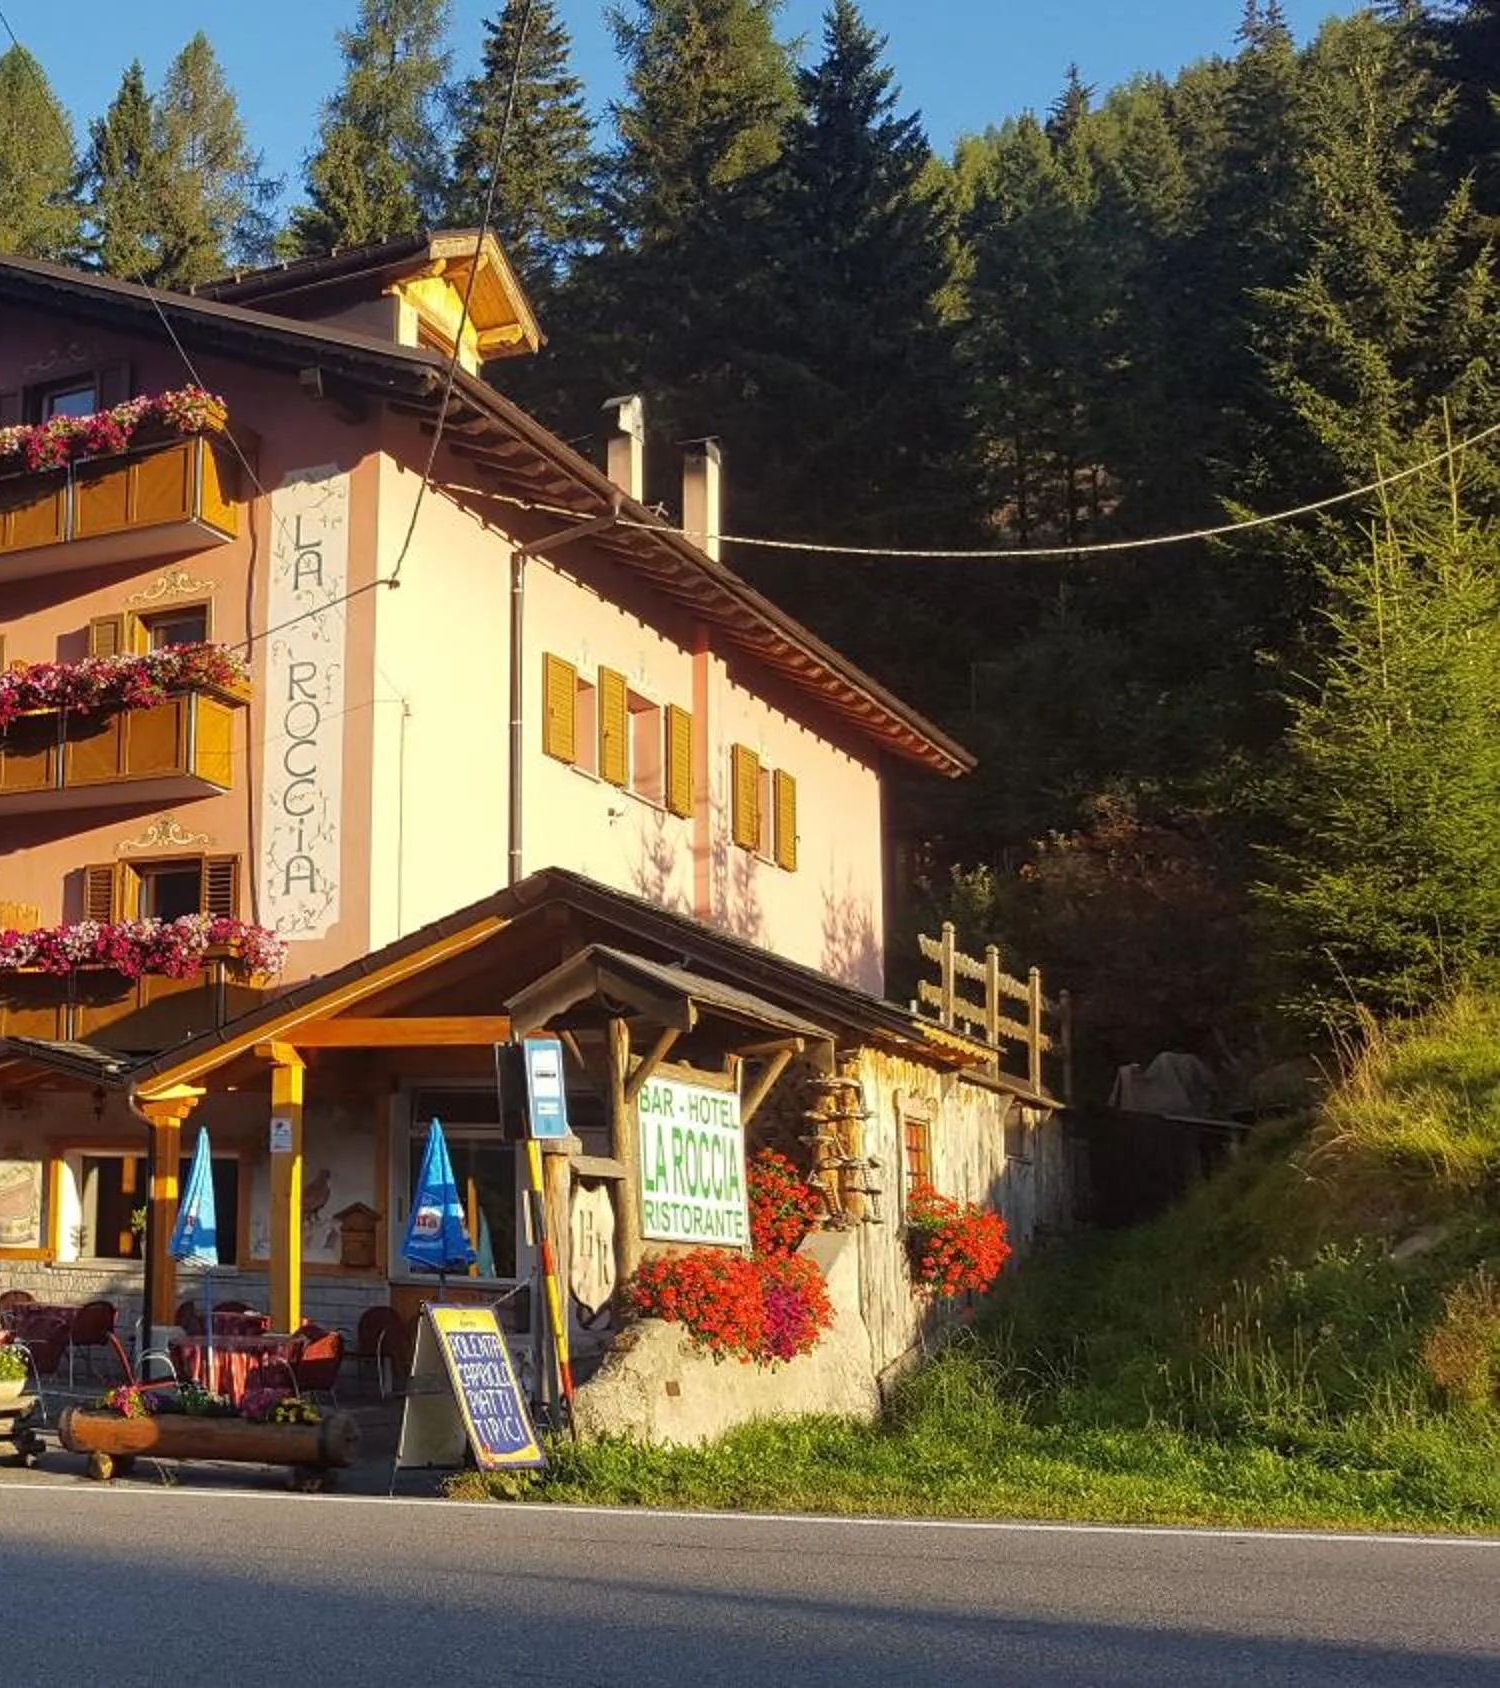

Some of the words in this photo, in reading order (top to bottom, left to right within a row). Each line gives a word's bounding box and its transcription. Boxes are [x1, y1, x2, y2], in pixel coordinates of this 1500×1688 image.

[293, 514, 323, 591] LA
[639, 1084, 674, 1118] BAR
[688, 1092, 741, 1130] HOTEL
[642, 1121, 669, 1194] LA
[672, 1126, 741, 1203] ROCCIA
[643, 1199, 744, 1239] RISTORANTE
[466, 1388, 514, 1415] PIATTI
[473, 1415, 527, 1444] TIPICI
